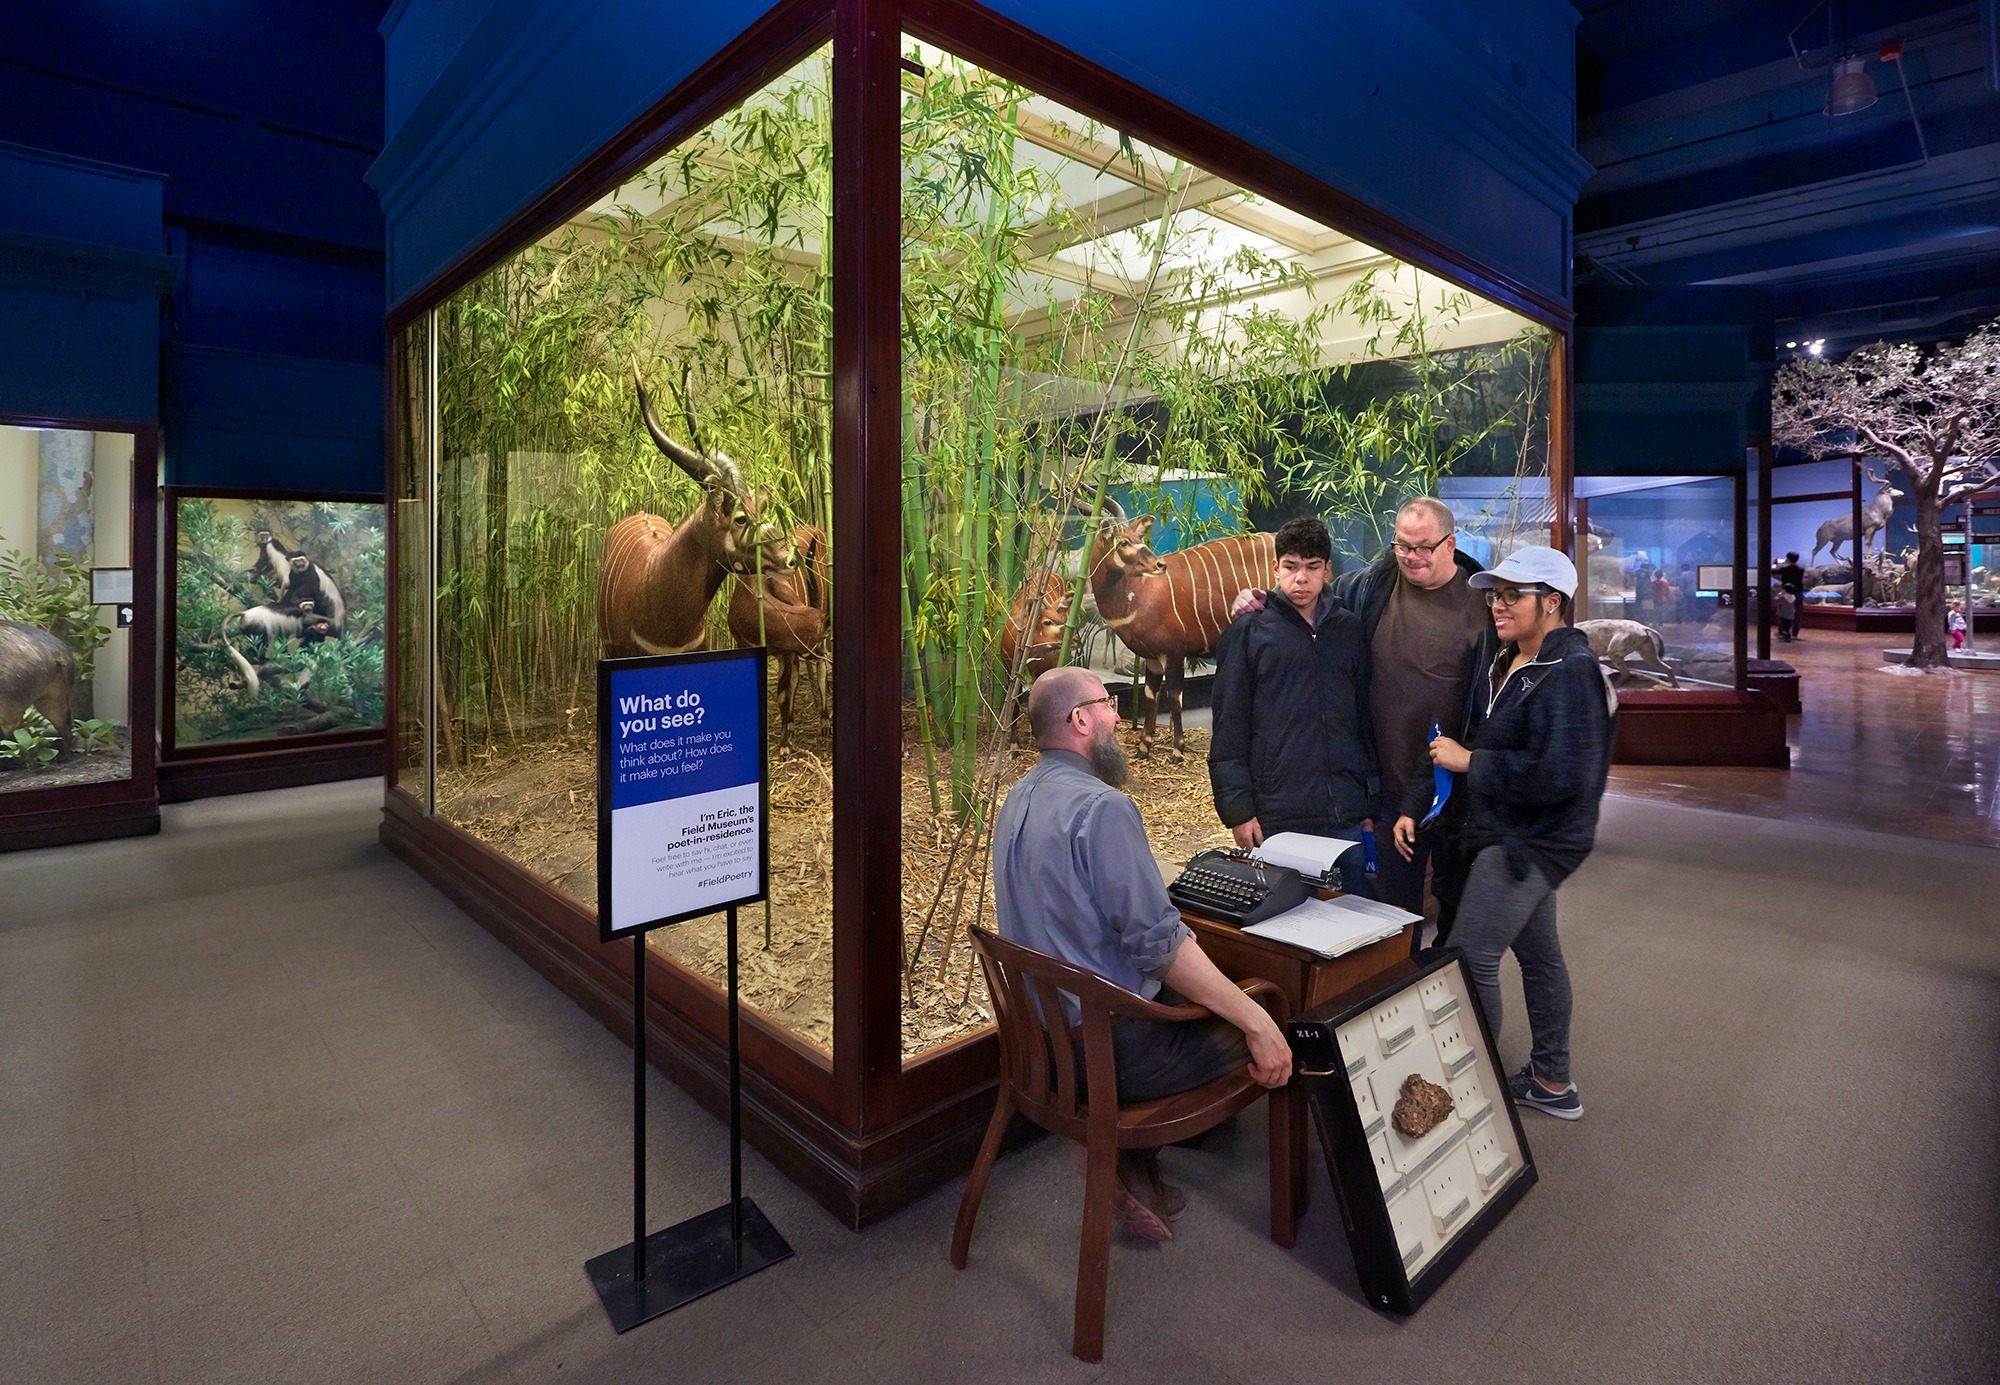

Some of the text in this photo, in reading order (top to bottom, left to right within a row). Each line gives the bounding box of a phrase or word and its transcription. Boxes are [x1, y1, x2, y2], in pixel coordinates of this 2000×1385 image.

[619, 689, 701, 715] What do
[619, 707, 705, 739] you see?
[619, 730, 731, 754] What does it make you
[620, 743, 733, 769] think about? How does
[620, 759, 703, 783] it make you feel?
[700, 804, 754, 822] I'm Eric, the
[681, 815, 754, 836] Field Museum's
[667, 826, 754, 851] poet-in-residence.
[651, 855, 666, 864] Feel
[667, 853, 682, 861] free
[683, 850, 690, 858] to
[691, 849, 702, 857] say
[738, 838, 753, 846] even
[656, 863, 674, 872] write
[674, 859, 690, 868] with
[723, 848, 746, 857] excited
[668, 870, 684, 878] hear
[685, 865, 703, 874] what
[703, 862, 717, 871] you
[717, 858, 734, 867] have
[734, 856, 741, 864] to
[698, 870, 753, 888] #FieldPoetry
[1381, 1295, 1389, 1304] 2
